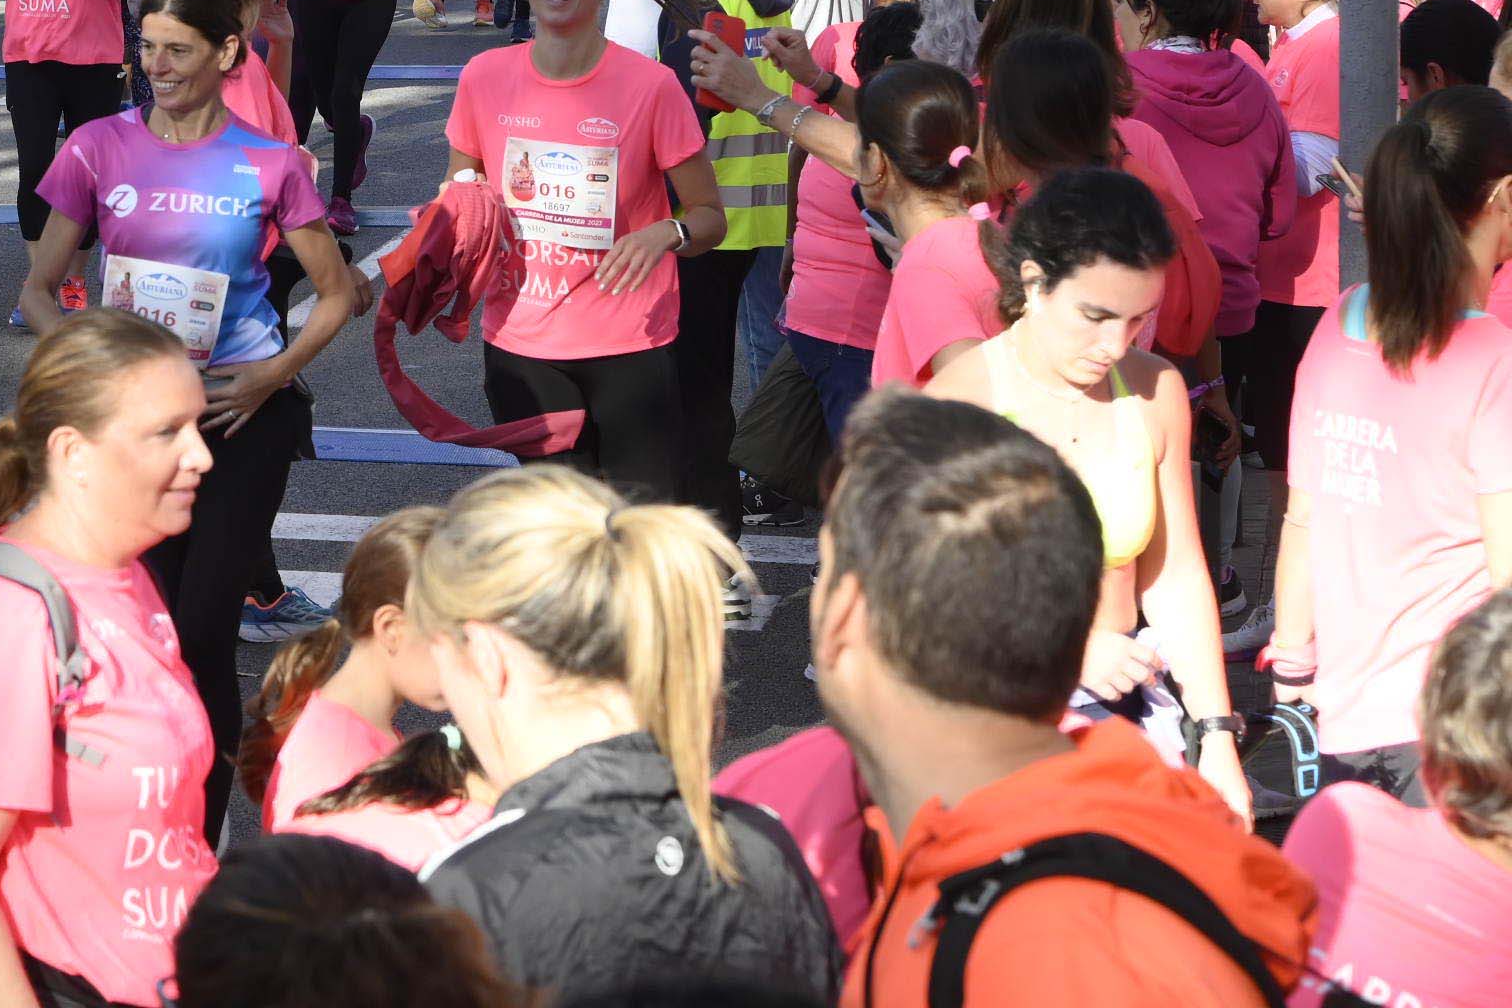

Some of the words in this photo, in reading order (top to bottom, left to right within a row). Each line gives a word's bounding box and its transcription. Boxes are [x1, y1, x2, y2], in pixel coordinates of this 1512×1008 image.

[498, 113, 541, 129] OYSHO
[539, 182, 575, 199] 016
[149, 192, 250, 217] ZURICH
[543, 201, 571, 213] 18697
[515, 209, 545, 220] CARRERA
[545, 213, 553, 222] DE
[563, 216, 586, 226] MUJER
[587, 218, 603, 226] 2023
[569, 231, 606, 242] Santander
[140, 280, 184, 297] ASTURIANA
[131, 767, 179, 810] TU
